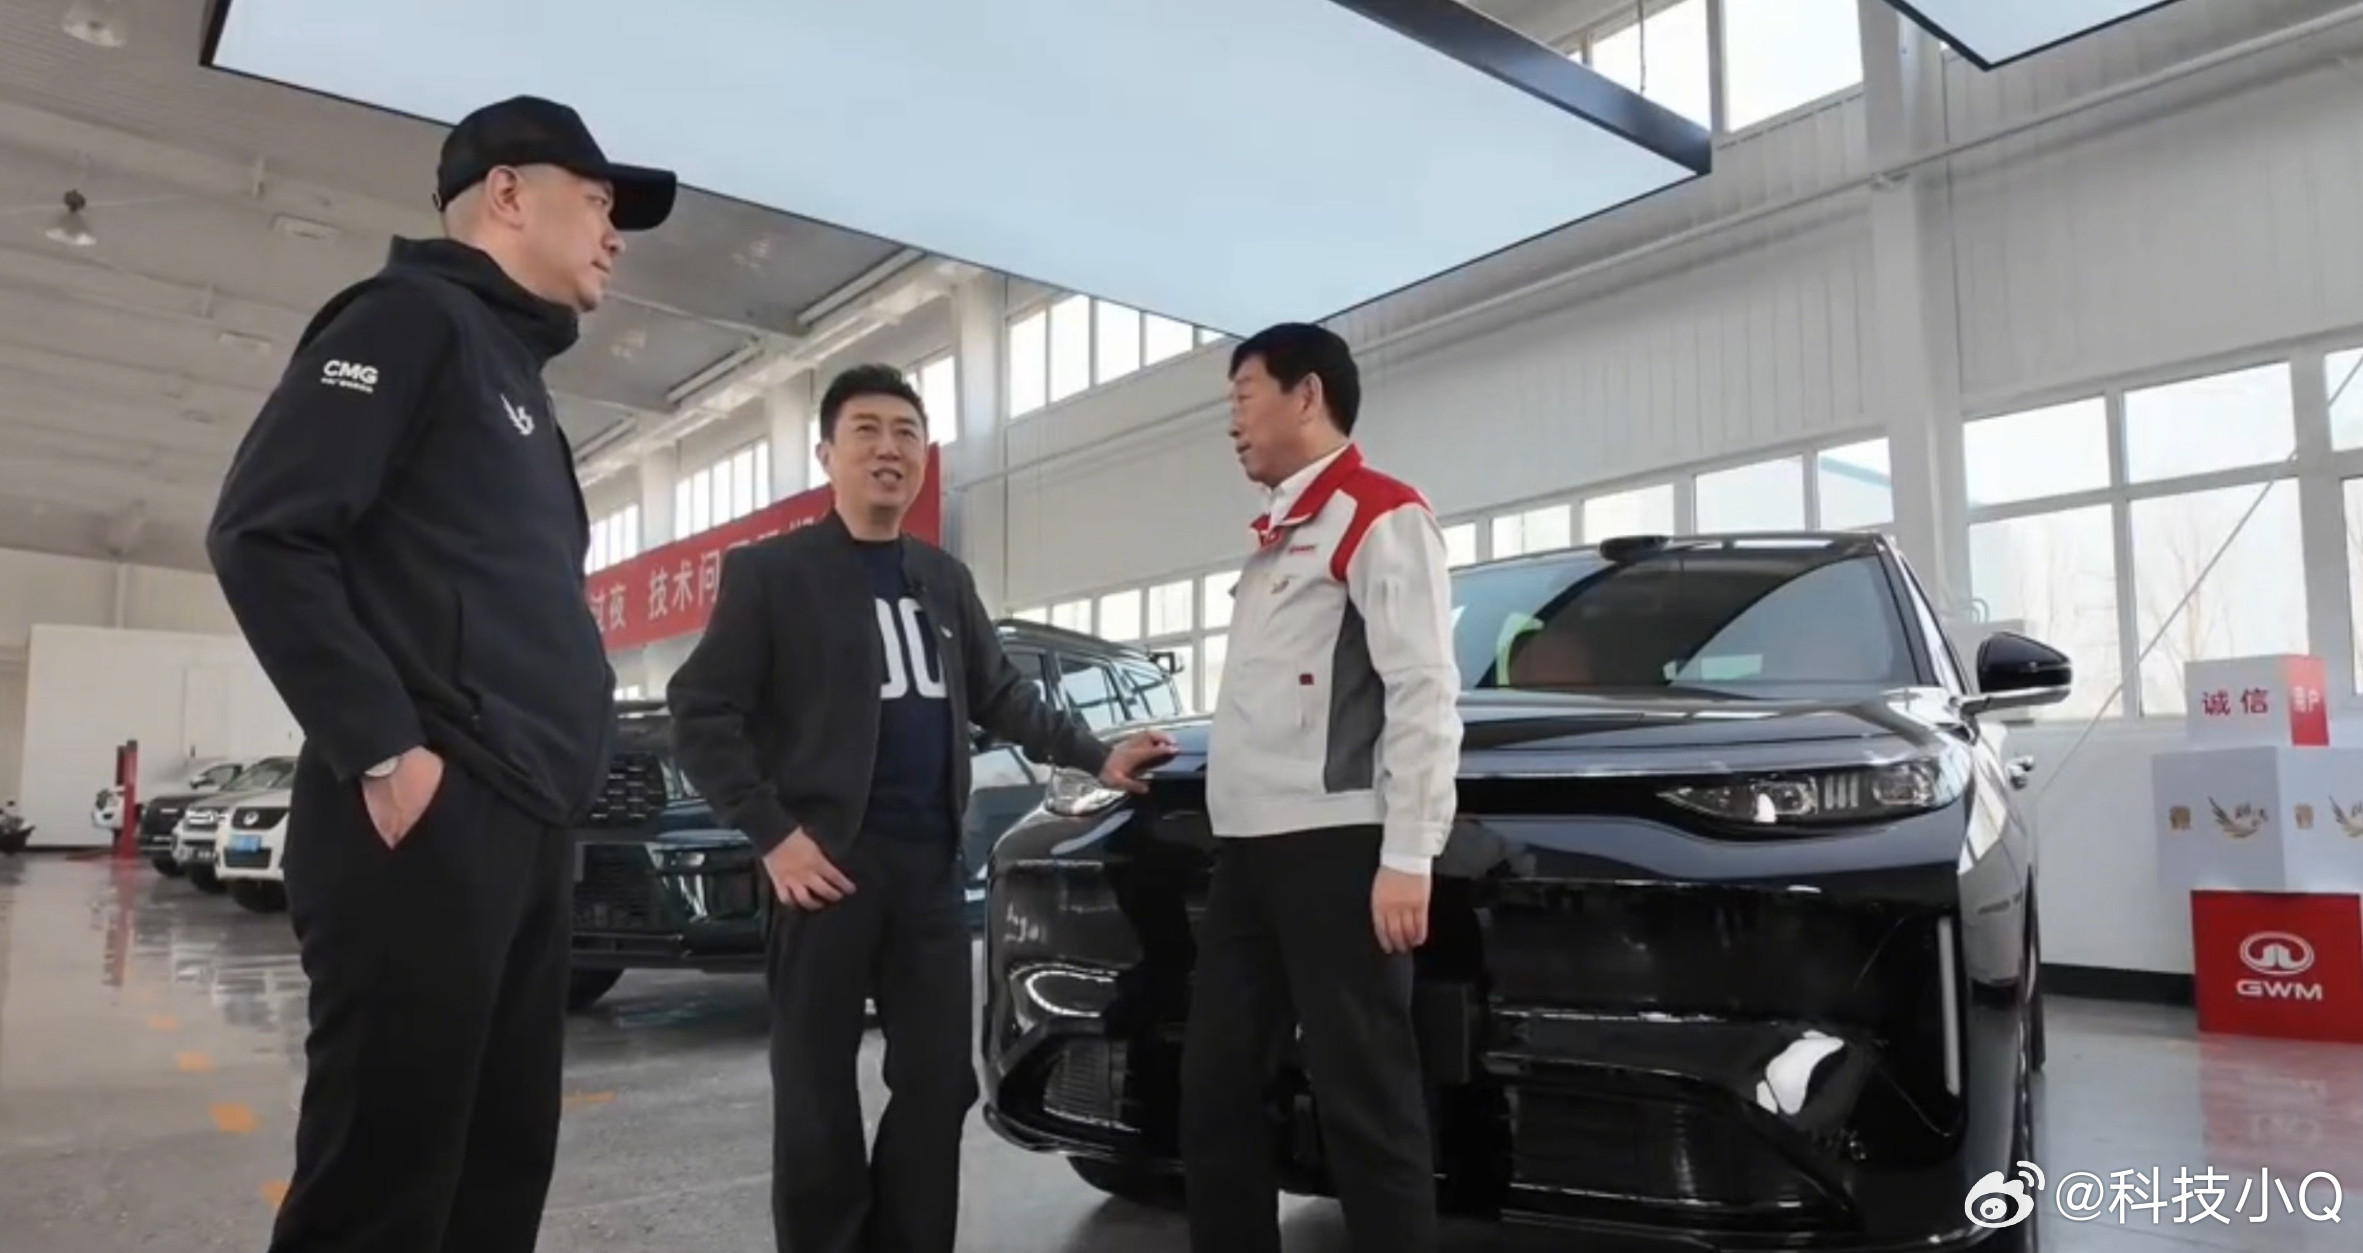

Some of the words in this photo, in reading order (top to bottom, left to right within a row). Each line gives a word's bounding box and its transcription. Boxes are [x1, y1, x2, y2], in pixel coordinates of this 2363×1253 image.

[323, 359, 378, 384] CMG
[2202, 687, 2269, 715] 诚信
[2236, 979, 2323, 1001] GWM
